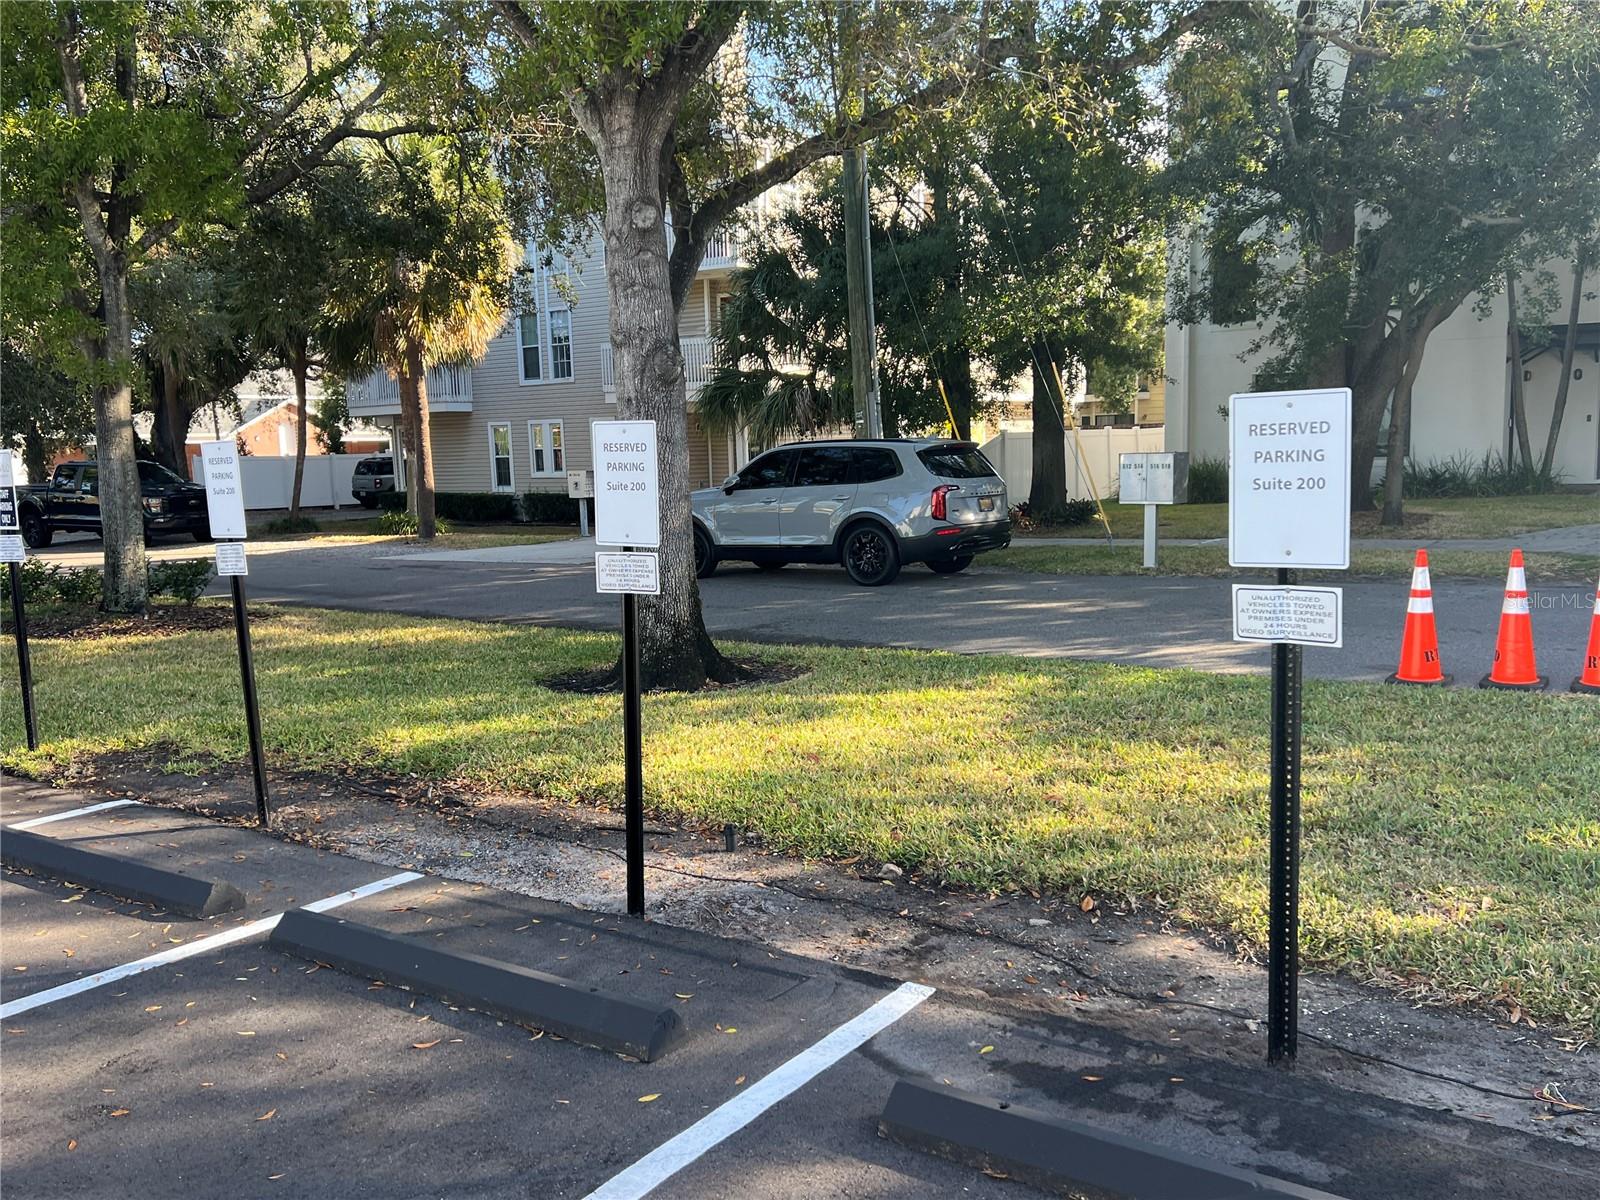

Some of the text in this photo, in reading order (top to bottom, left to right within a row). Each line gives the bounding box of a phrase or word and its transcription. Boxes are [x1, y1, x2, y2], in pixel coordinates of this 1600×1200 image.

[1249, 421, 1330, 436] RESERVED
[603, 443, 647, 452] RESERVED
[1254, 449, 1325, 463] PARKING
[208, 457, 233, 465] RESERVED
[607, 462, 645, 471] PARKING
[211, 472, 233, 480] PARKING
[606, 481, 646, 491] Suite 200
[1253, 477, 1326, 490] Suite 200
[212, 487, 225, 495] Suite
[1251, 595, 1321, 603] UNAUTHORIZED
[1293, 610, 1335, 618] EXPENSE
[1266, 630, 1333, 639] SURVEILLANCE
